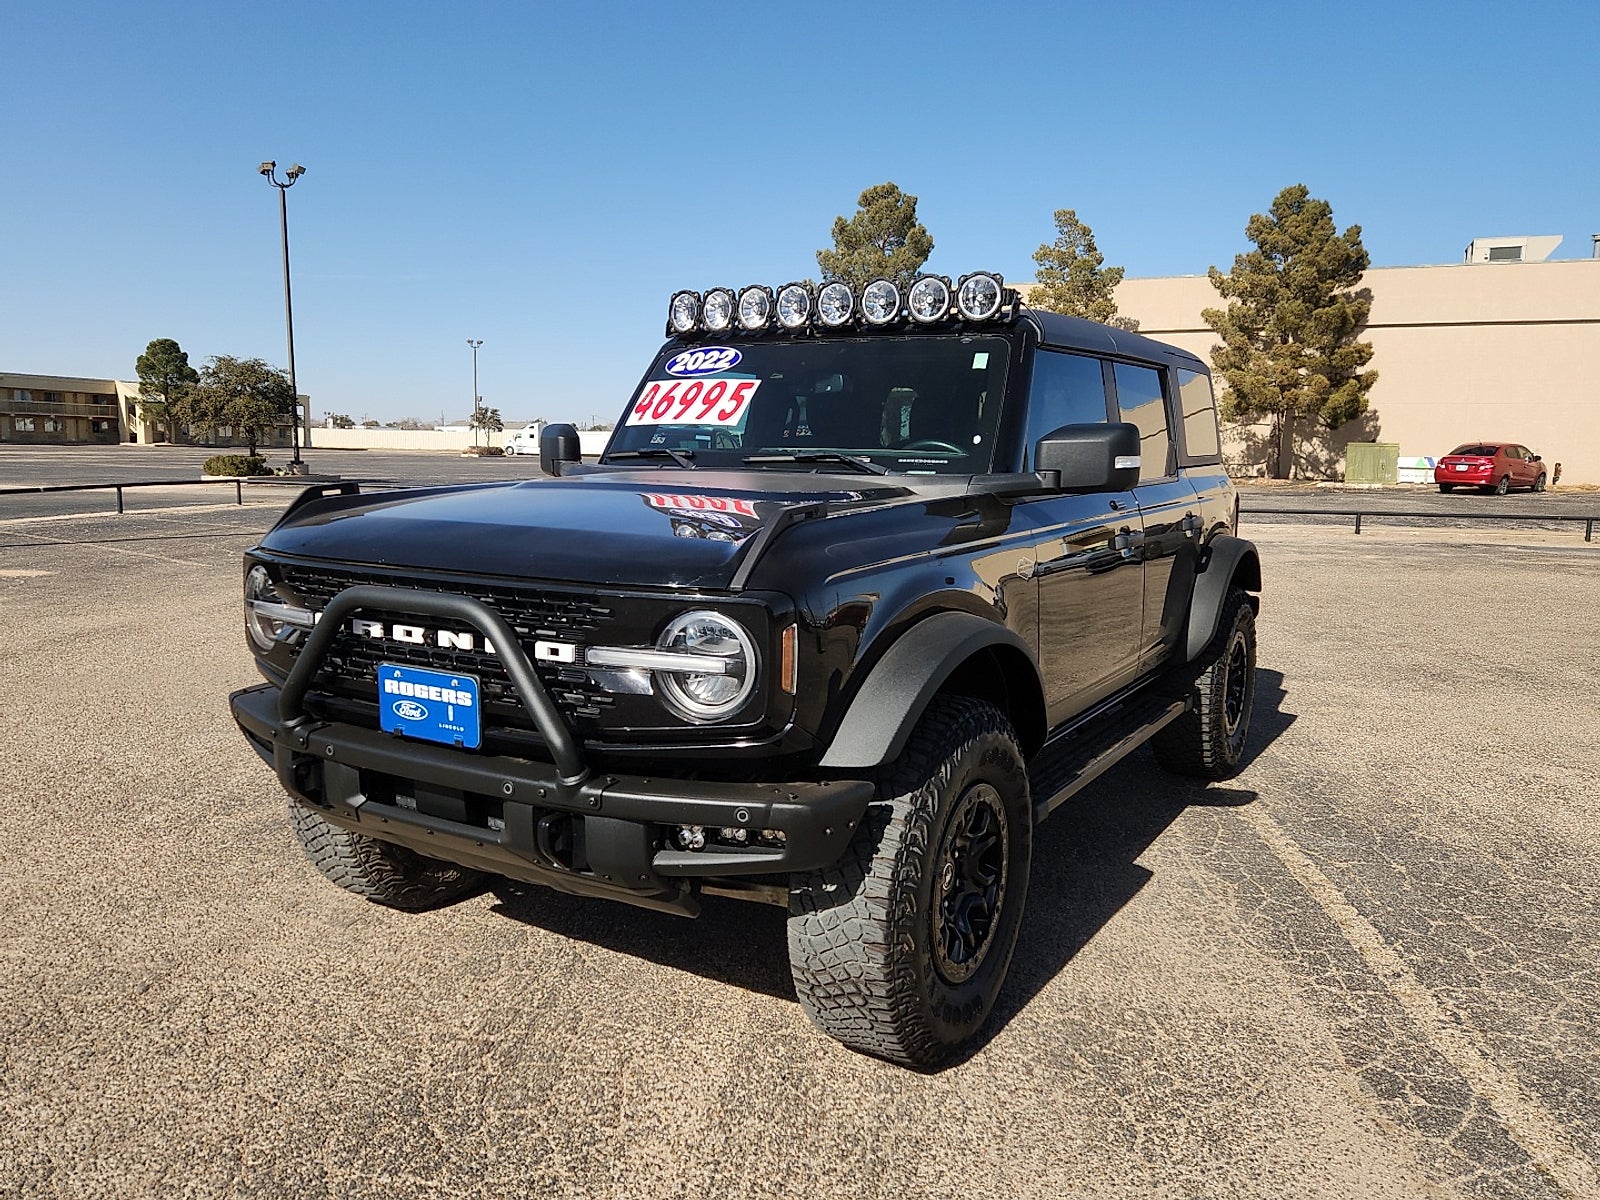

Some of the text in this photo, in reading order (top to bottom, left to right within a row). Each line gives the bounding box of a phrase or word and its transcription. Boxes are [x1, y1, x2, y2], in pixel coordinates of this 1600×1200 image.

[670, 350, 736, 372] 2022
[634, 380, 755, 421] 46995
[314, 611, 576, 664] RONO
[384, 679, 472, 706] ROGERS
[399, 703, 421, 717] Ford
